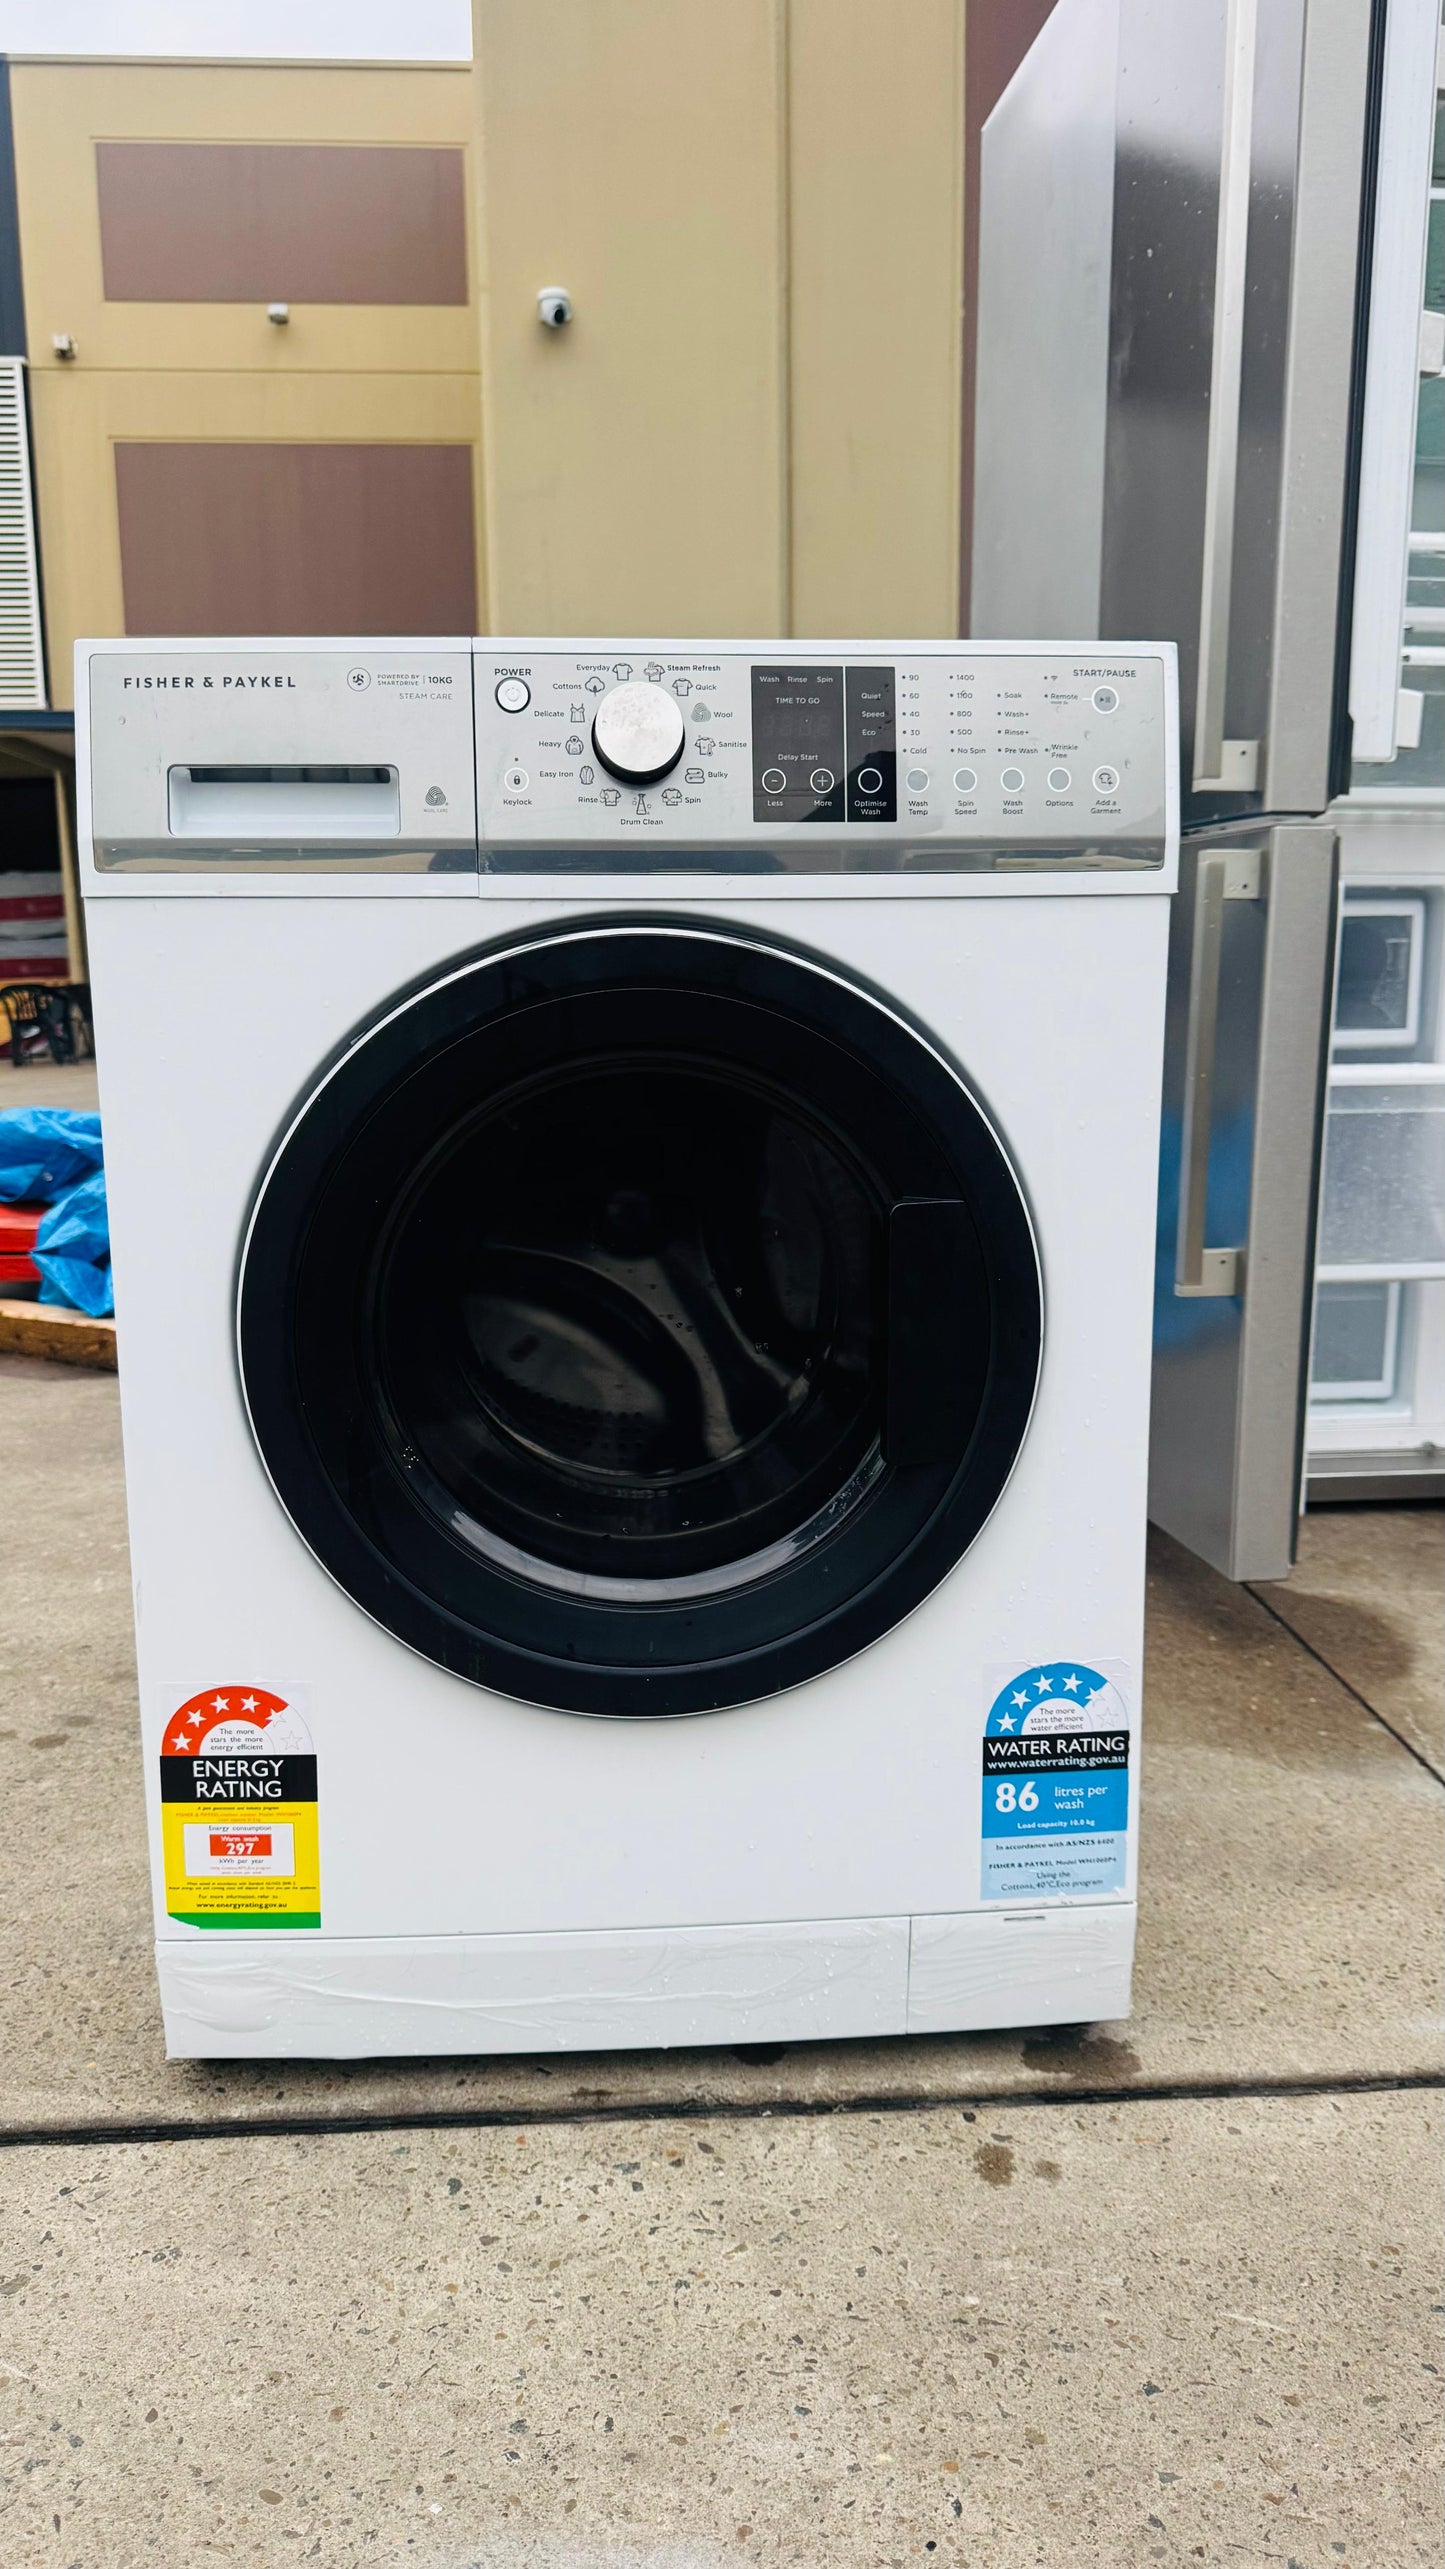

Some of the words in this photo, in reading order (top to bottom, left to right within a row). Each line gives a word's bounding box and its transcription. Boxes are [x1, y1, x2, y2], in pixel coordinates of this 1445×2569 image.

[577, 664, 610, 672] Everyday
[1073, 669, 1136, 677] START/PAUSE
[123, 677, 194, 688] FISHER
[203, 677, 214, 688] &
[223, 676, 296, 688] PAYKEL
[428, 676, 452, 684] 10KG
[816, 676, 833, 684] Spin
[503, 798, 532, 806] Keylock
[685, 796, 701, 805] Spin
[958, 800, 974, 808] Spin
[1046, 800, 1074, 808] Options
[955, 808, 977, 816] Speed
[988, 1740, 1051, 1756] WATER
[1057, 1736, 1125, 1754] RATING
[988, 1755, 1126, 1770] www.waterrating.gov.au
[192, 1760, 284, 1778] ENERGY
[196, 1781, 282, 1798] RATING
[1054, 1786, 1084, 1797] litres
[1088, 1786, 1108, 1799] per
[995, 1781, 1040, 1813] 86
[1054, 1798, 1084, 1810] wash
[1037, 1820, 1068, 1829] capacity
[226, 1843, 254, 1856] 297
[1005, 1842, 1046, 1850] accordance
